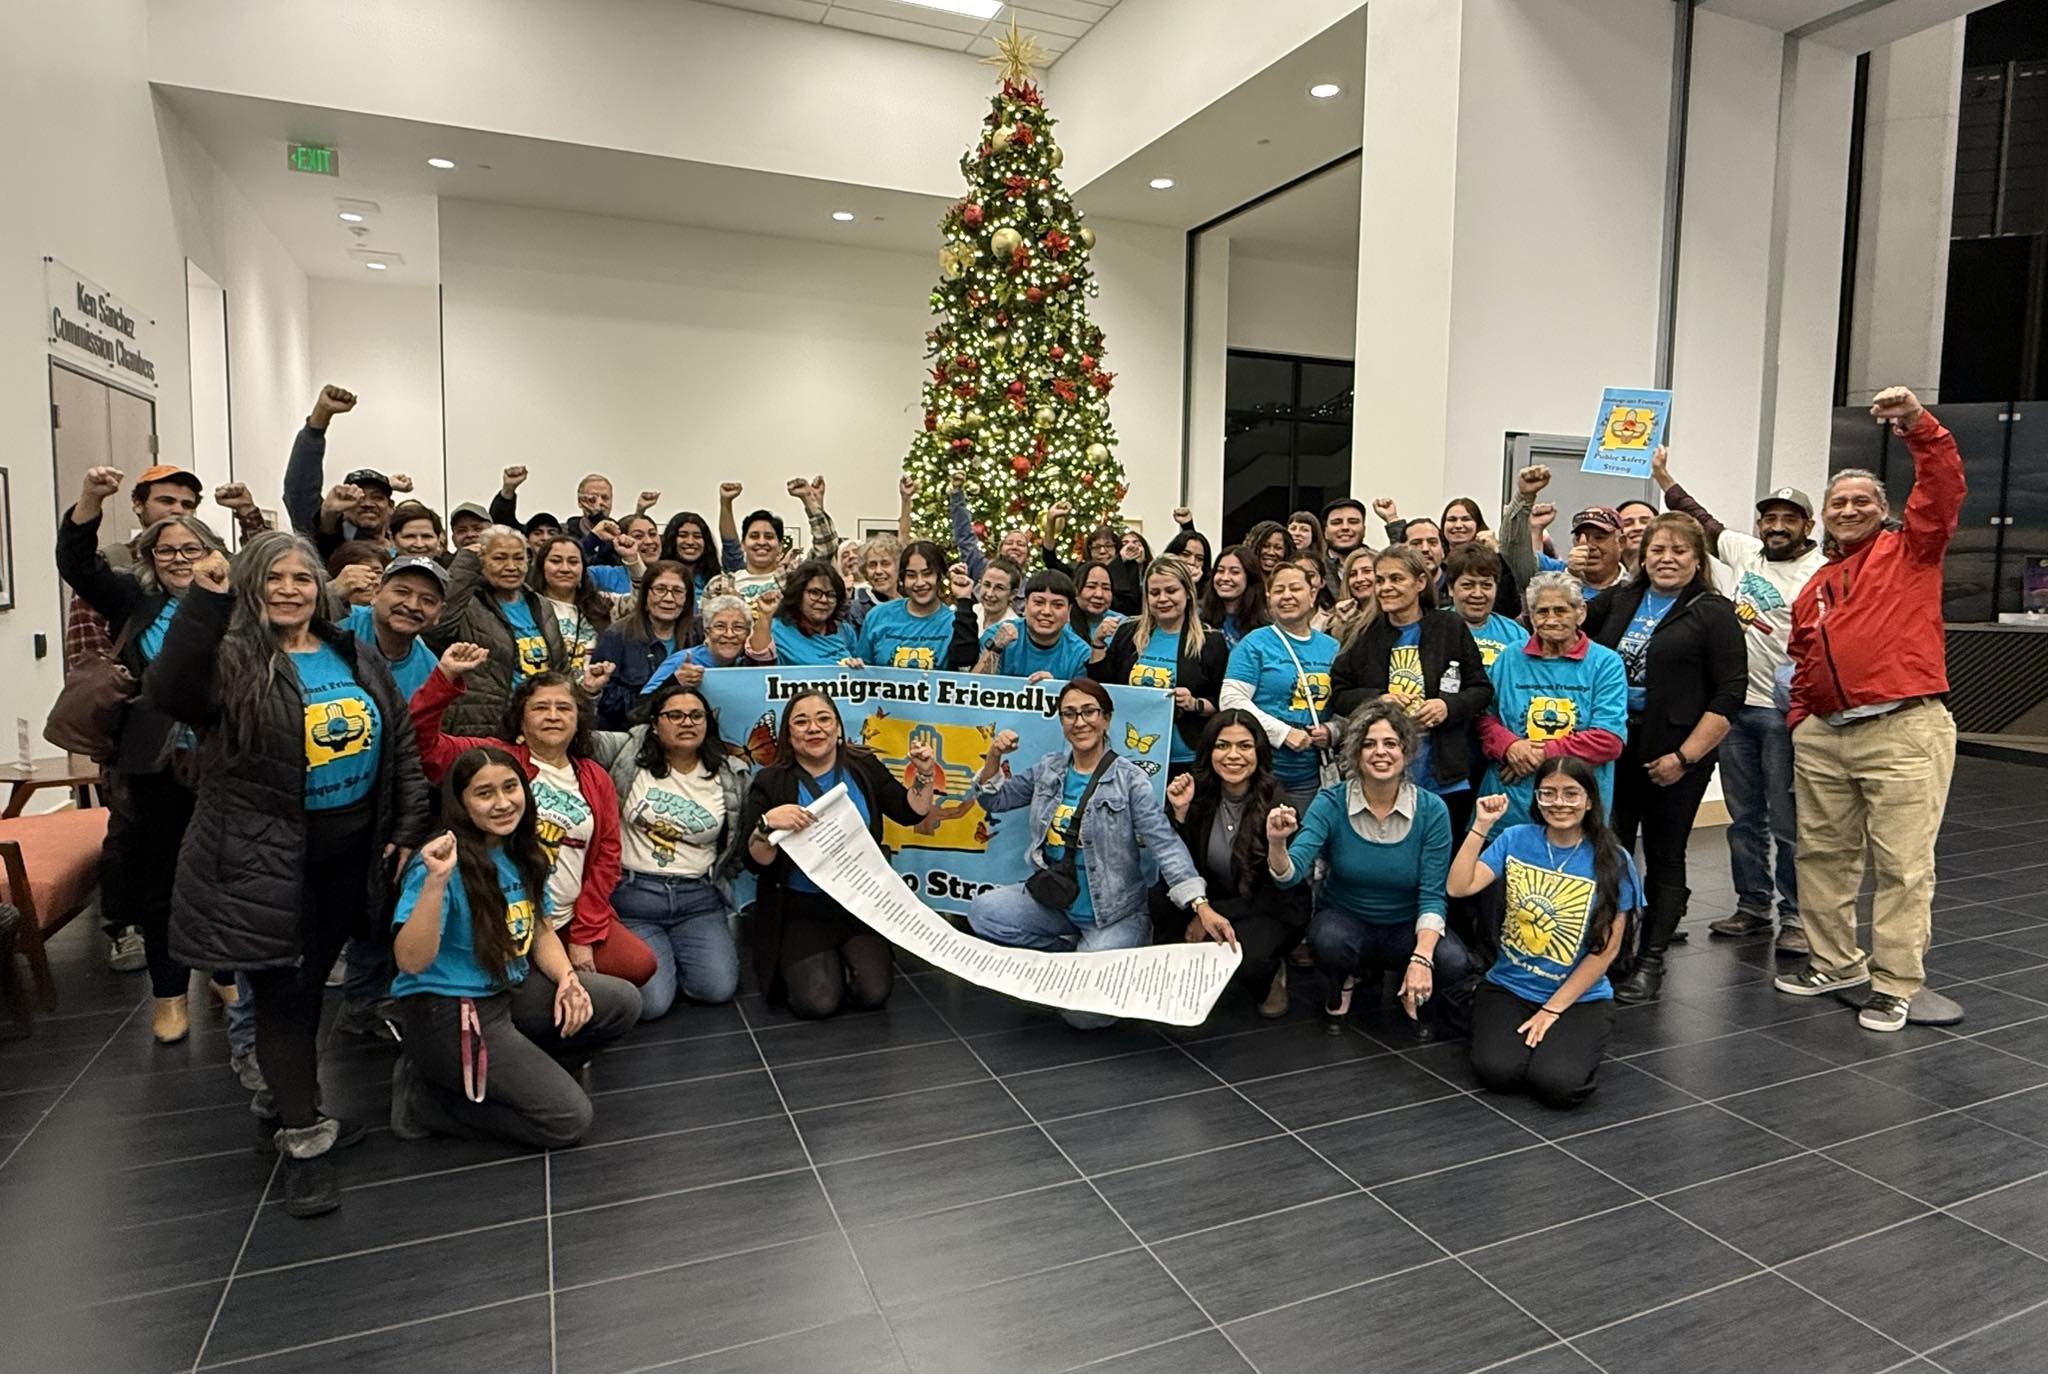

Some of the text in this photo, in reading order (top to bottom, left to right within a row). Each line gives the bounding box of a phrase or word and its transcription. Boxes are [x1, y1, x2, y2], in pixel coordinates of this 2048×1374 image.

[297, 147, 330, 172] EXIT
[77, 281, 136, 340] Ken Sanchez
[53, 306, 155, 381] Commission Chambers
[1594, 452, 1647, 465] Public Safety
[1603, 462, 1632, 473] Strong
[767, 675, 1059, 718] Immigrant Friendly
